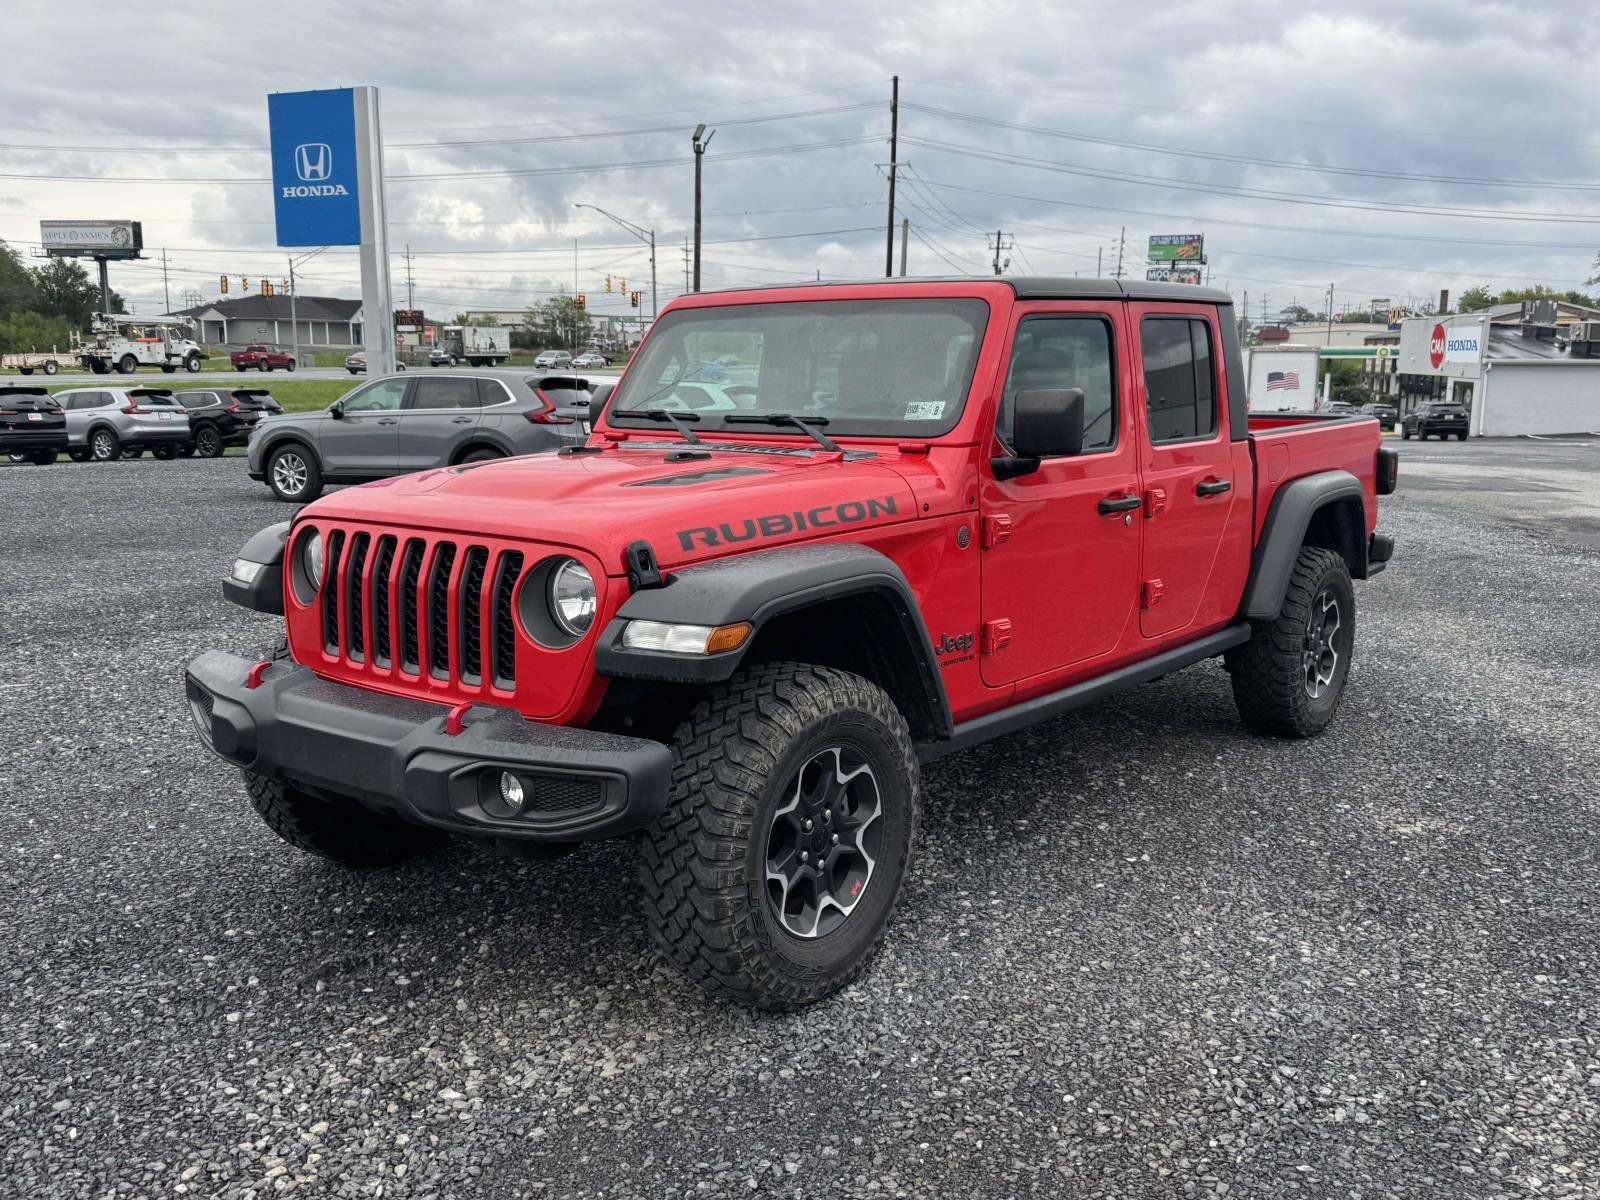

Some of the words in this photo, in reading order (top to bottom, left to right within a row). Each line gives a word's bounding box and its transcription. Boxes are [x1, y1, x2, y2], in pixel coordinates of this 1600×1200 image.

[282, 184, 349, 198] HONDA
[1430, 338, 1444, 354] CMA
[1447, 339, 1479, 352] HONDA
[677, 496, 898, 551] RUBICON
[935, 632, 975, 656] Jeep
